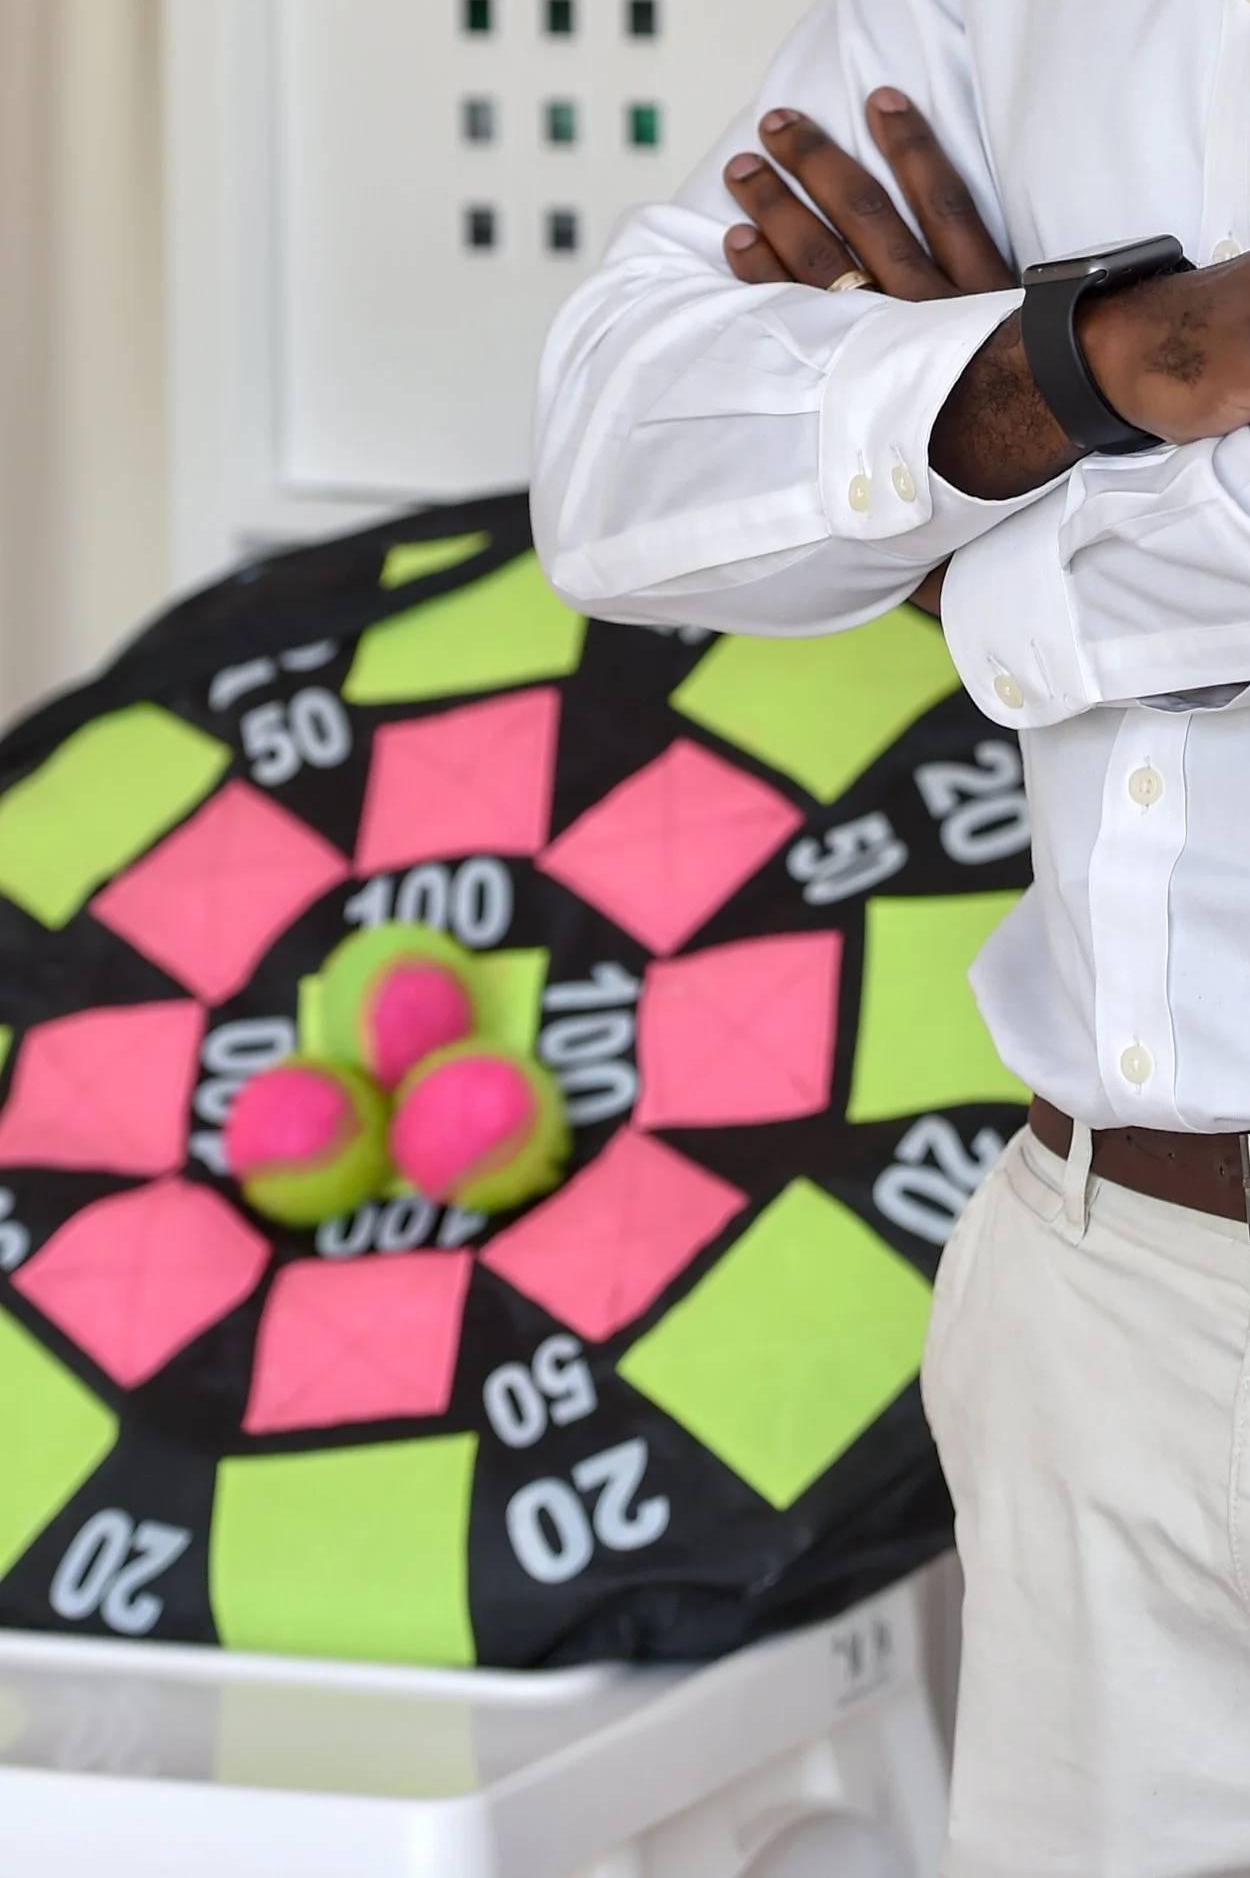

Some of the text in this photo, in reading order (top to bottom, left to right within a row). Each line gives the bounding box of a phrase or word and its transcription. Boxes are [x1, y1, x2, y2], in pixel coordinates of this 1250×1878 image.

[240, 686, 354, 786] 50
[913, 739, 1031, 865] 20
[539, 960, 643, 1126] 100
[872, 1113, 1005, 1246] 20
[483, 1333, 598, 1450] 50
[48, 1507, 193, 1637] 20
[504, 1437, 672, 1585] 20
